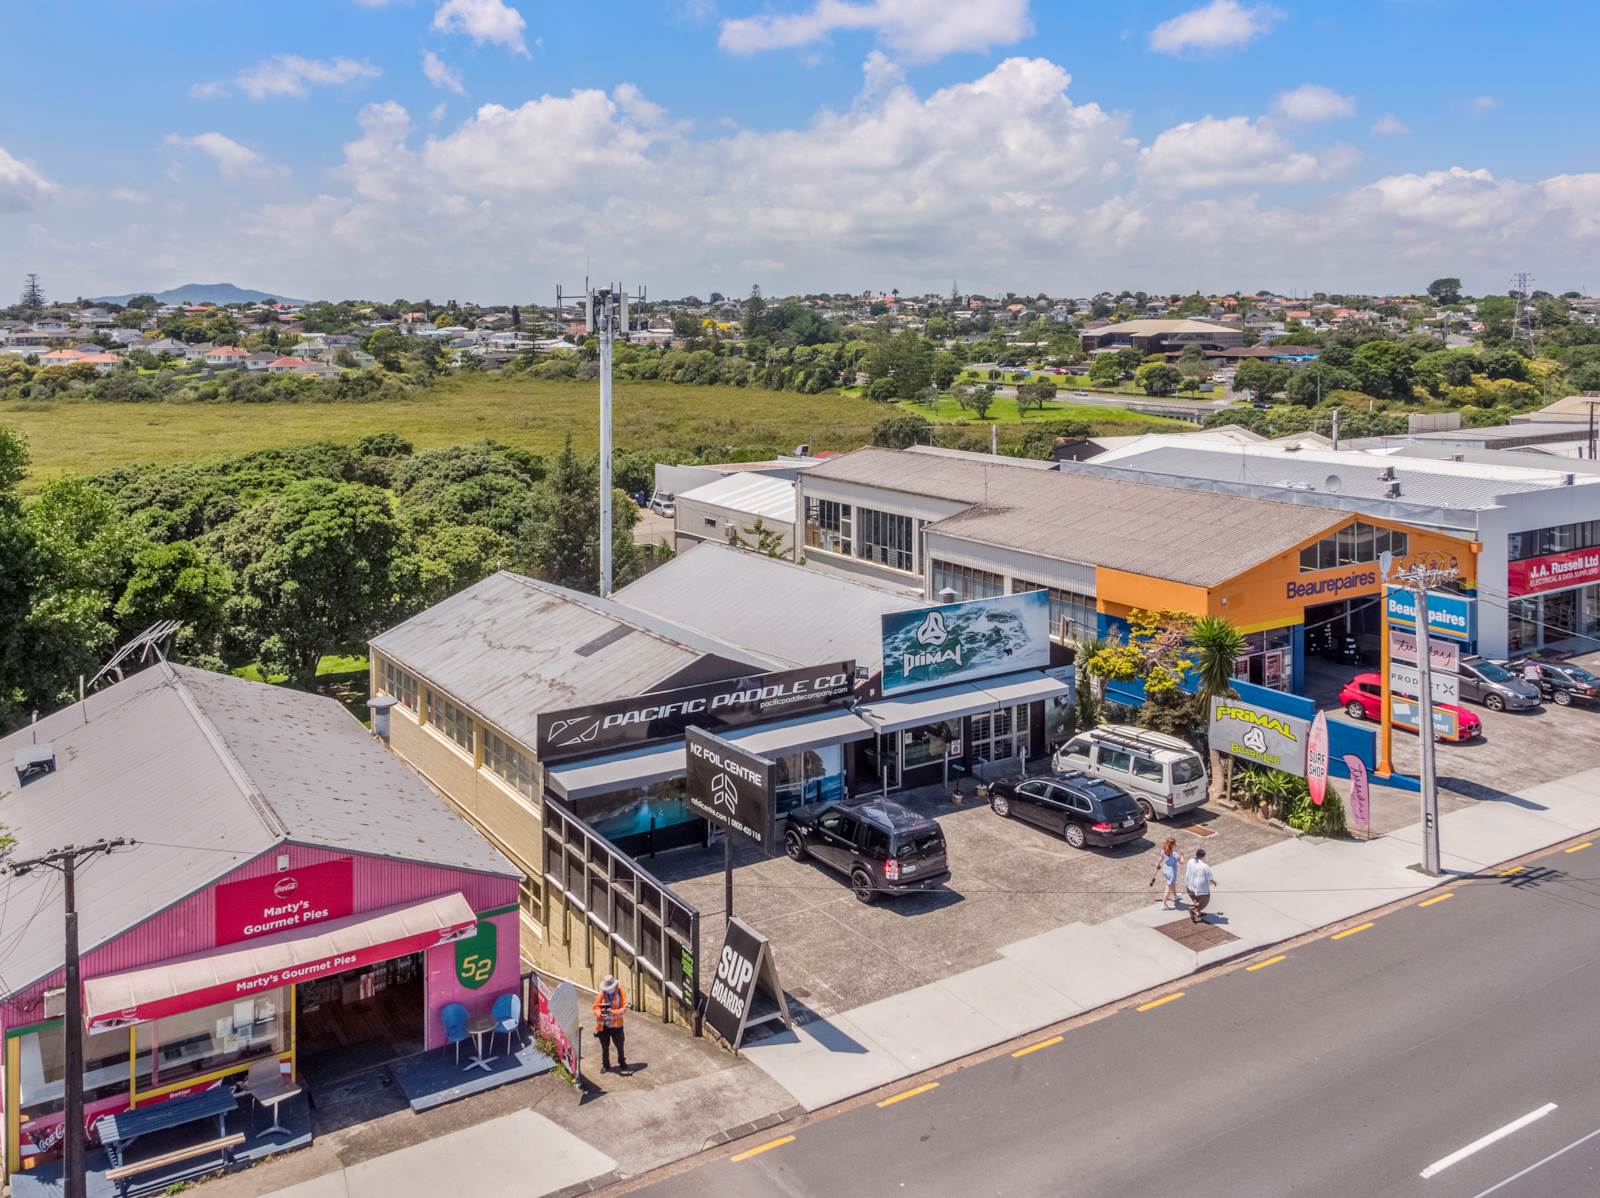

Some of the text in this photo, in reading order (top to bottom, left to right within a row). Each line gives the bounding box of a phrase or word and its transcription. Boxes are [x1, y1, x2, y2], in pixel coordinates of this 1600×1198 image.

[1551, 557, 1583, 574] Russell
[1584, 554, 1599, 568] Ltd
[1286, 571, 1376, 599] Beaurepaires
[1388, 600, 1465, 627] Beaupaires
[1391, 673, 1440, 690] PRODT
[602, 673, 848, 729] PACIFIC PADDLE CO.
[760, 687, 848, 709] pacificpaddlecompany.com
[690, 742, 762, 787] NZ FOIL CENTRE
[1309, 751, 1325, 765] SURF
[1309, 764, 1325, 777] SHOP
[243, 908, 328, 935] Gourmet Pies
[264, 900, 310, 918] Marty's
[236, 954, 357, 991] Marty's Gourmet Pies
[461, 955, 491, 981] 52
[718, 945, 753, 993] SUP
[711, 978, 744, 1019] BOARDS
